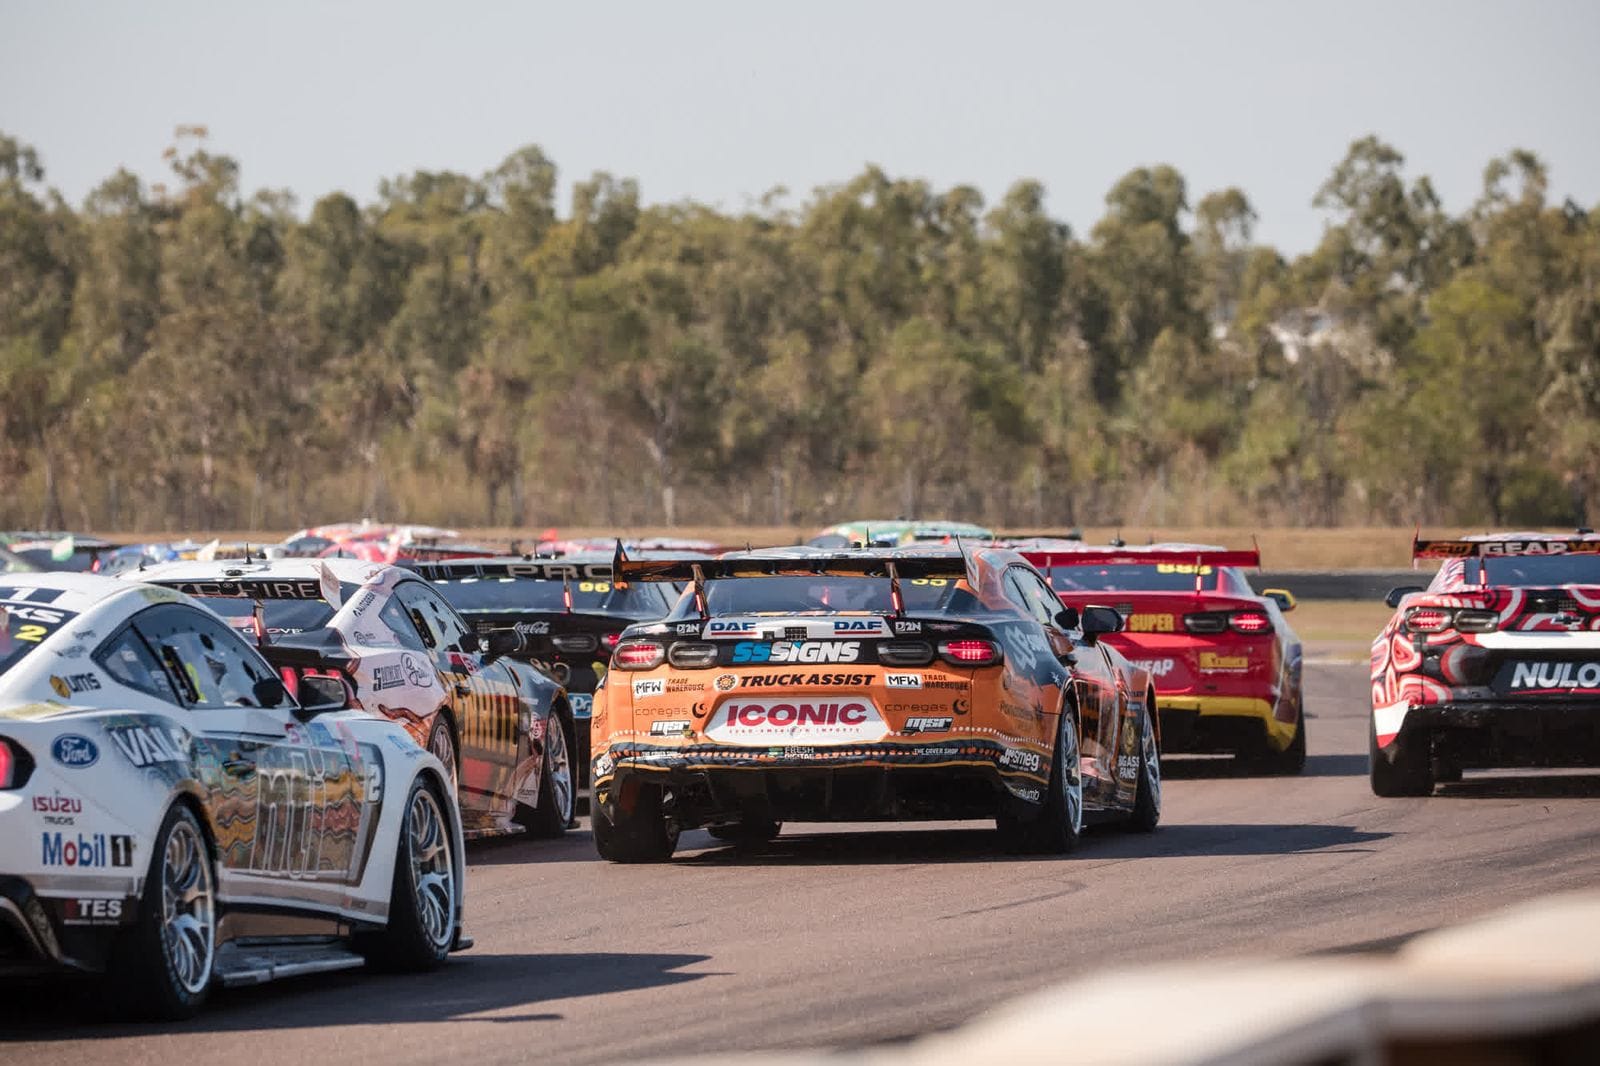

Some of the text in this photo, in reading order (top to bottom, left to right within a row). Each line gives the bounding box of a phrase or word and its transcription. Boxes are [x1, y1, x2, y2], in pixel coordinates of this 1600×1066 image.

[711, 622, 756, 631] DAF
[834, 621, 882, 630] DAF
[1129, 613, 1174, 632] SUPER
[14, 624, 48, 642] 2
[635, 681, 662, 695] MFW
[887, 675, 919, 686] MFW
[635, 706, 688, 717] coregas
[727, 703, 867, 727] ICONIC
[884, 703, 948, 714] coregas
[60, 738, 91, 763] Ford
[1011, 750, 1040, 771] smeg
[33, 796, 82, 813] ISUZU
[42, 832, 106, 867] Mobil
